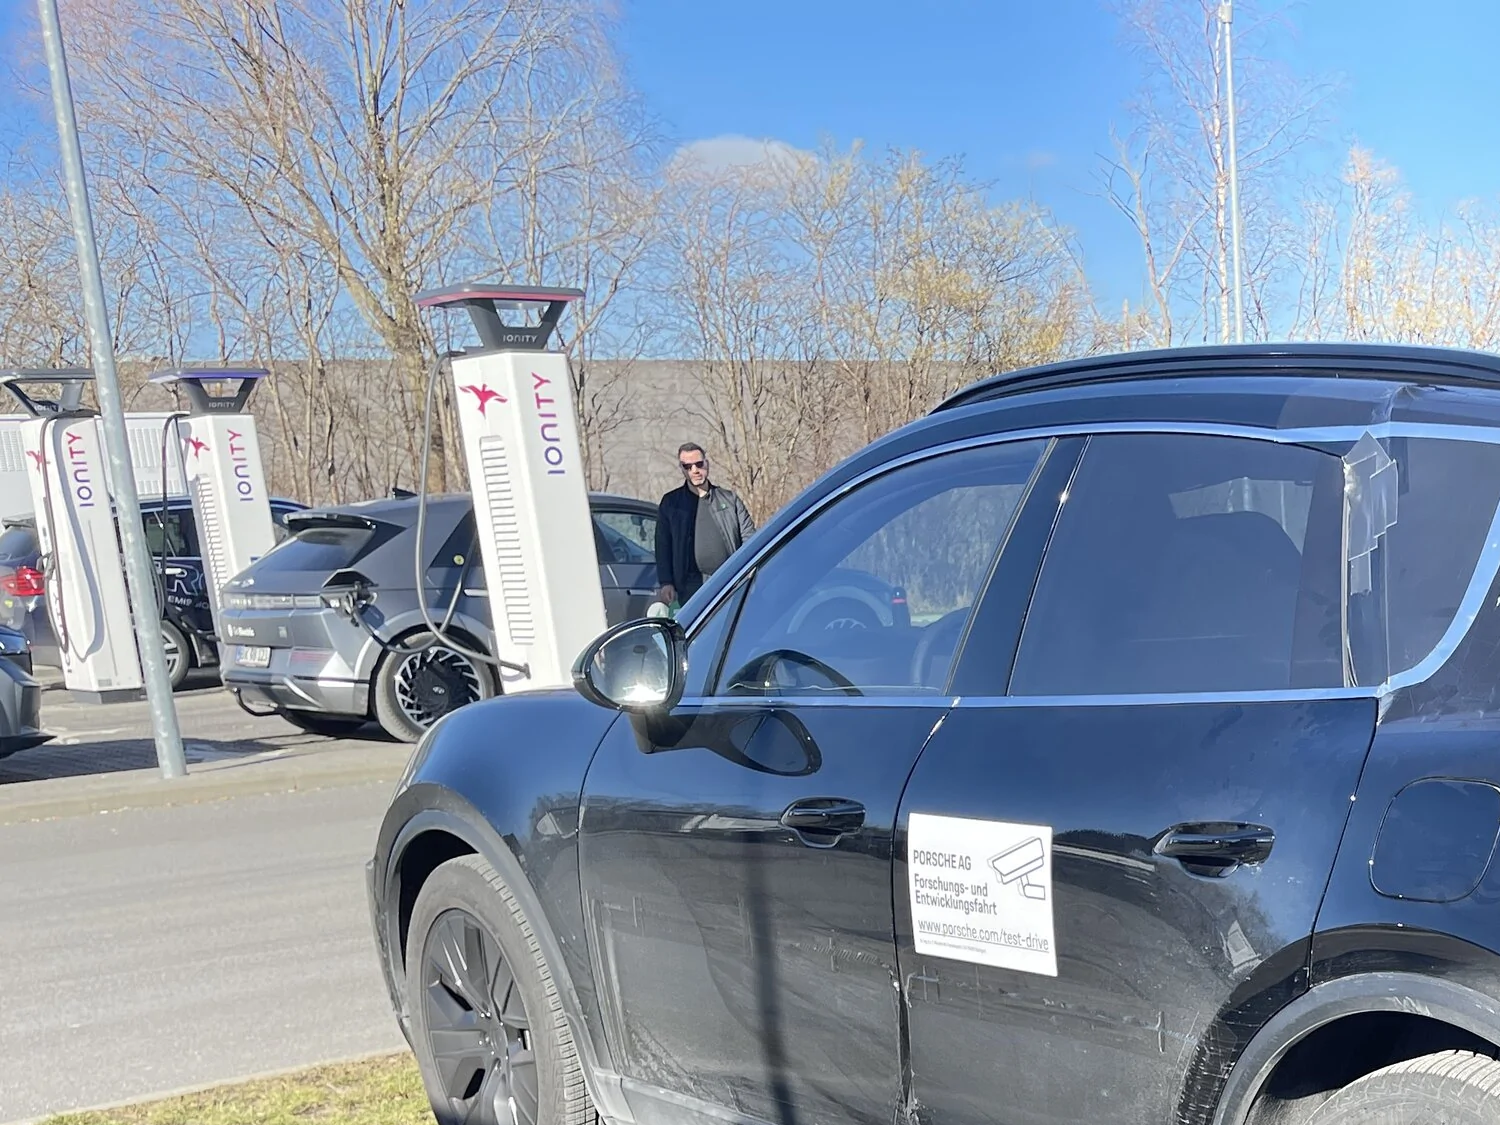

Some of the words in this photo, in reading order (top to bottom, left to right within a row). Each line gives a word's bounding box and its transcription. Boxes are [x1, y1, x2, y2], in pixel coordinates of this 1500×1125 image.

[502, 334, 538, 343] IONITY
[531, 371, 565, 474] IONITY
[66, 432, 95, 507] IONITY
[227, 429, 254, 502] IONITY
[913, 849, 957, 870] PORSCHE
[958, 855, 972, 871] AG
[914, 873, 969, 897] Forschungs-
[970, 882, 988, 897] und
[915, 890, 998, 915] Entwicklungsfahrt
[918, 919, 1049, 951] www.porsche.com/test-drive
